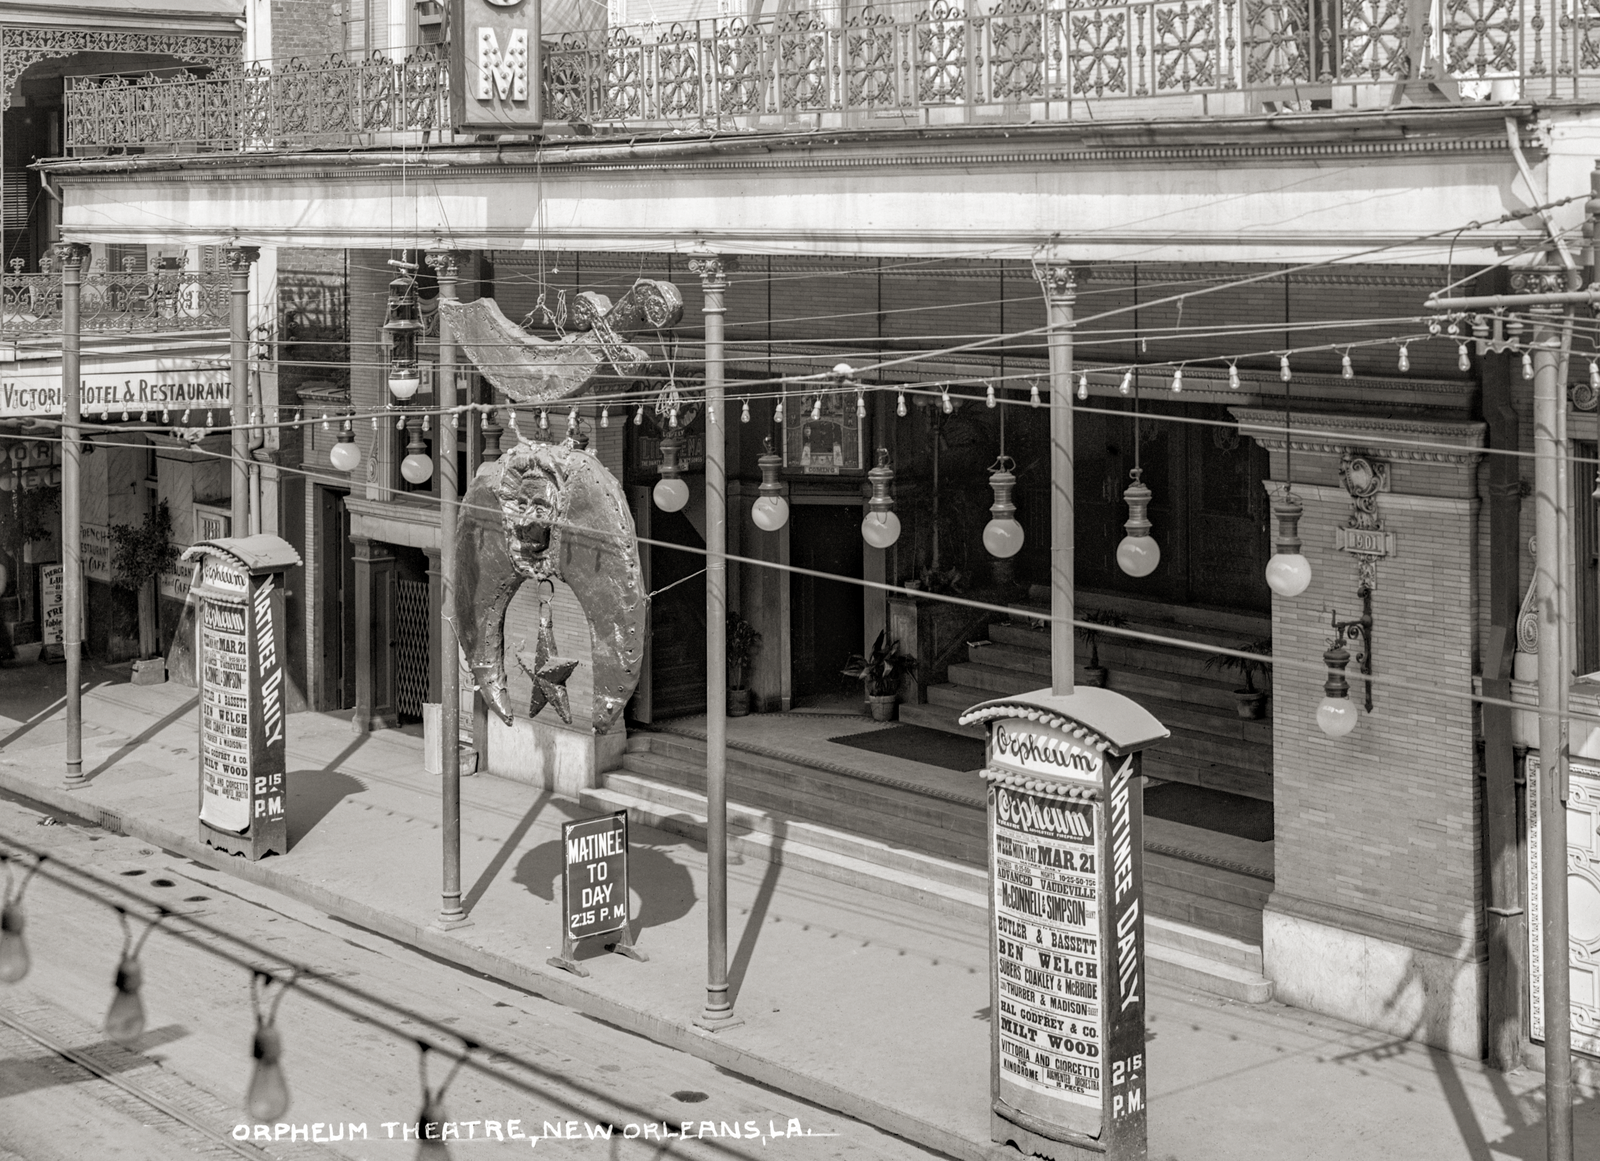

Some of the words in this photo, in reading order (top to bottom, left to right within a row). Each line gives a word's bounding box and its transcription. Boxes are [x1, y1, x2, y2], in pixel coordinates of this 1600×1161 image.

[123, 380, 135, 402] &
[140, 379, 231, 402] RESTAURANT
[253, 573, 276, 678] MATINEE
[238, 641, 247, 655] 21
[219, 709, 247, 725] WELCH
[261, 667, 283, 748] DAILY
[997, 725, 1097, 772] Orpheum
[222, 763, 248, 777] WOOD
[998, 789, 1092, 837] Orpheum
[1110, 753, 1134, 905] MATINEE
[568, 829, 624, 864] MATINEE
[1038, 845, 1077, 871] MAR.
[1079, 853, 1096, 874] 21
[586, 861, 607, 883] TO
[997, 867, 1033, 886] ADVANCED
[1040, 879, 1096, 899] VAUDEVILLE
[581, 883, 613, 908] DAY
[1002, 881, 1042, 917] McCONNELL
[1046, 894, 1086, 926] SIMPSON
[998, 915, 1027, 940] BUTLER
[1036, 928, 1043, 944] &
[1051, 931, 1097, 955] BASSETT
[999, 938, 1023, 961] BEN
[1038, 952, 1098, 979] WELCH
[1116, 898, 1139, 1013] DAILY
[1006, 981, 1035, 1003] THURBER
[1040, 994, 1046, 1007] &
[1050, 997, 1087, 1016] MADISON
[1024, 968, 1055, 990] COAKLEY
[1057, 978, 1062, 991] &
[1065, 979, 1098, 1000] McBRIDE
[1001, 1000, 1016, 1016] HAL
[1020, 1008, 1064, 1031] GODFREY
[1070, 1023, 1077, 1035] &
[1082, 1026, 1099, 1038] CO.
[1001, 1016, 1037, 1042] MILT
[1047, 1033, 1099, 1057] WOOD
[1001, 1038, 1030, 1061] VITTORIA
[1035, 1052, 1050, 1067] AND
[1003, 1058, 1039, 1081] KINODROME
[1064, 1083, 1085, 1094] PIECES
